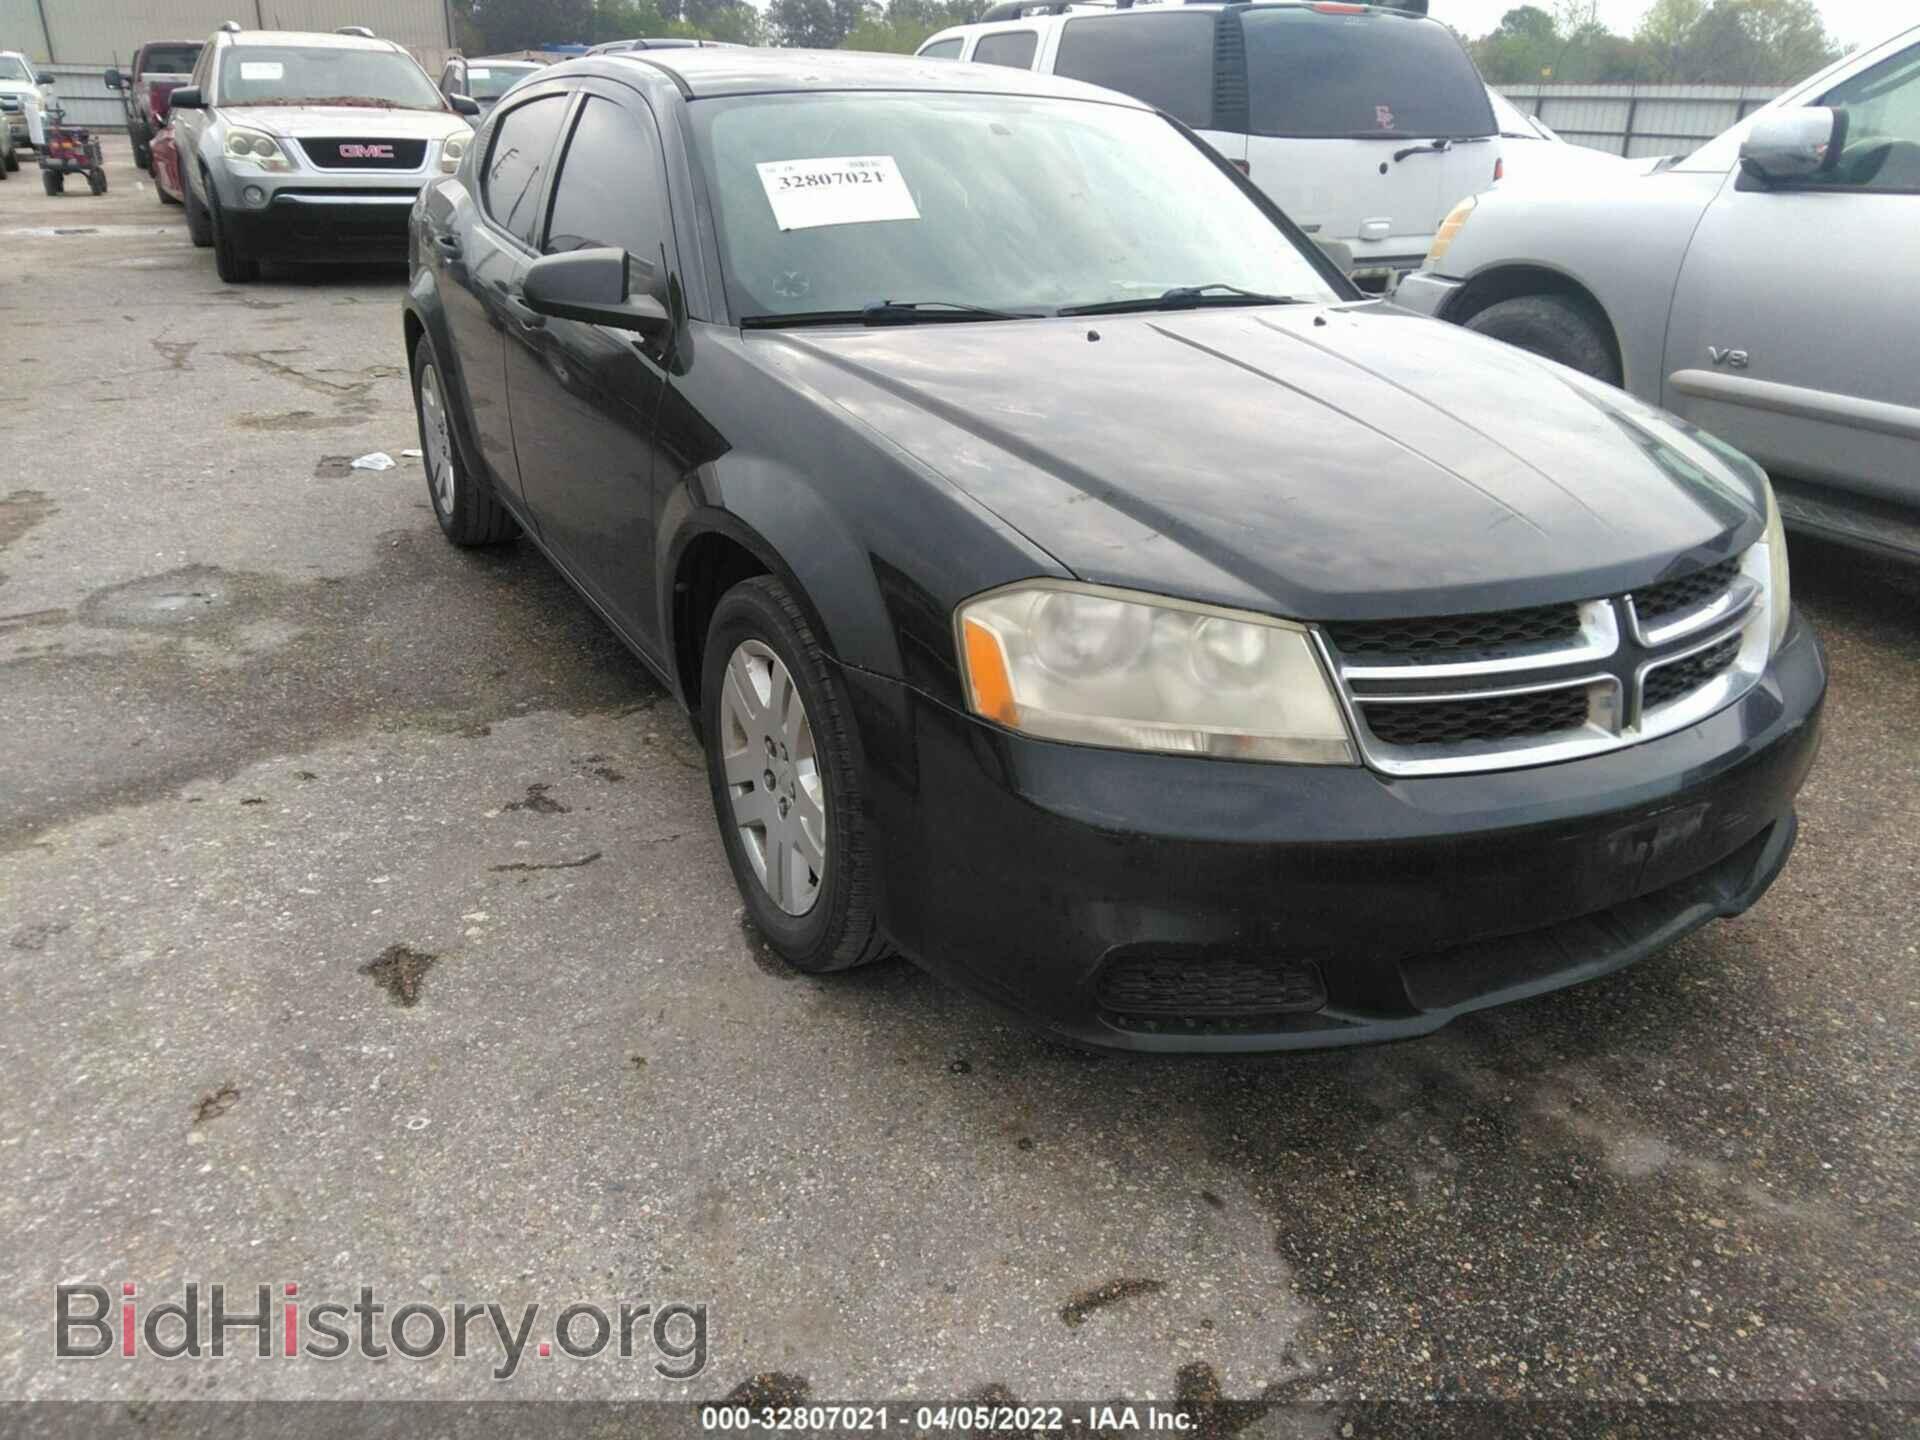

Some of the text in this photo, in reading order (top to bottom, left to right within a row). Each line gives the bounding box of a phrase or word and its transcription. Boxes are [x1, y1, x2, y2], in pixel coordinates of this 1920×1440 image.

[338, 144, 394, 158] GMC
[778, 171, 886, 190] 32807021
[1708, 346, 1748, 368] V8
